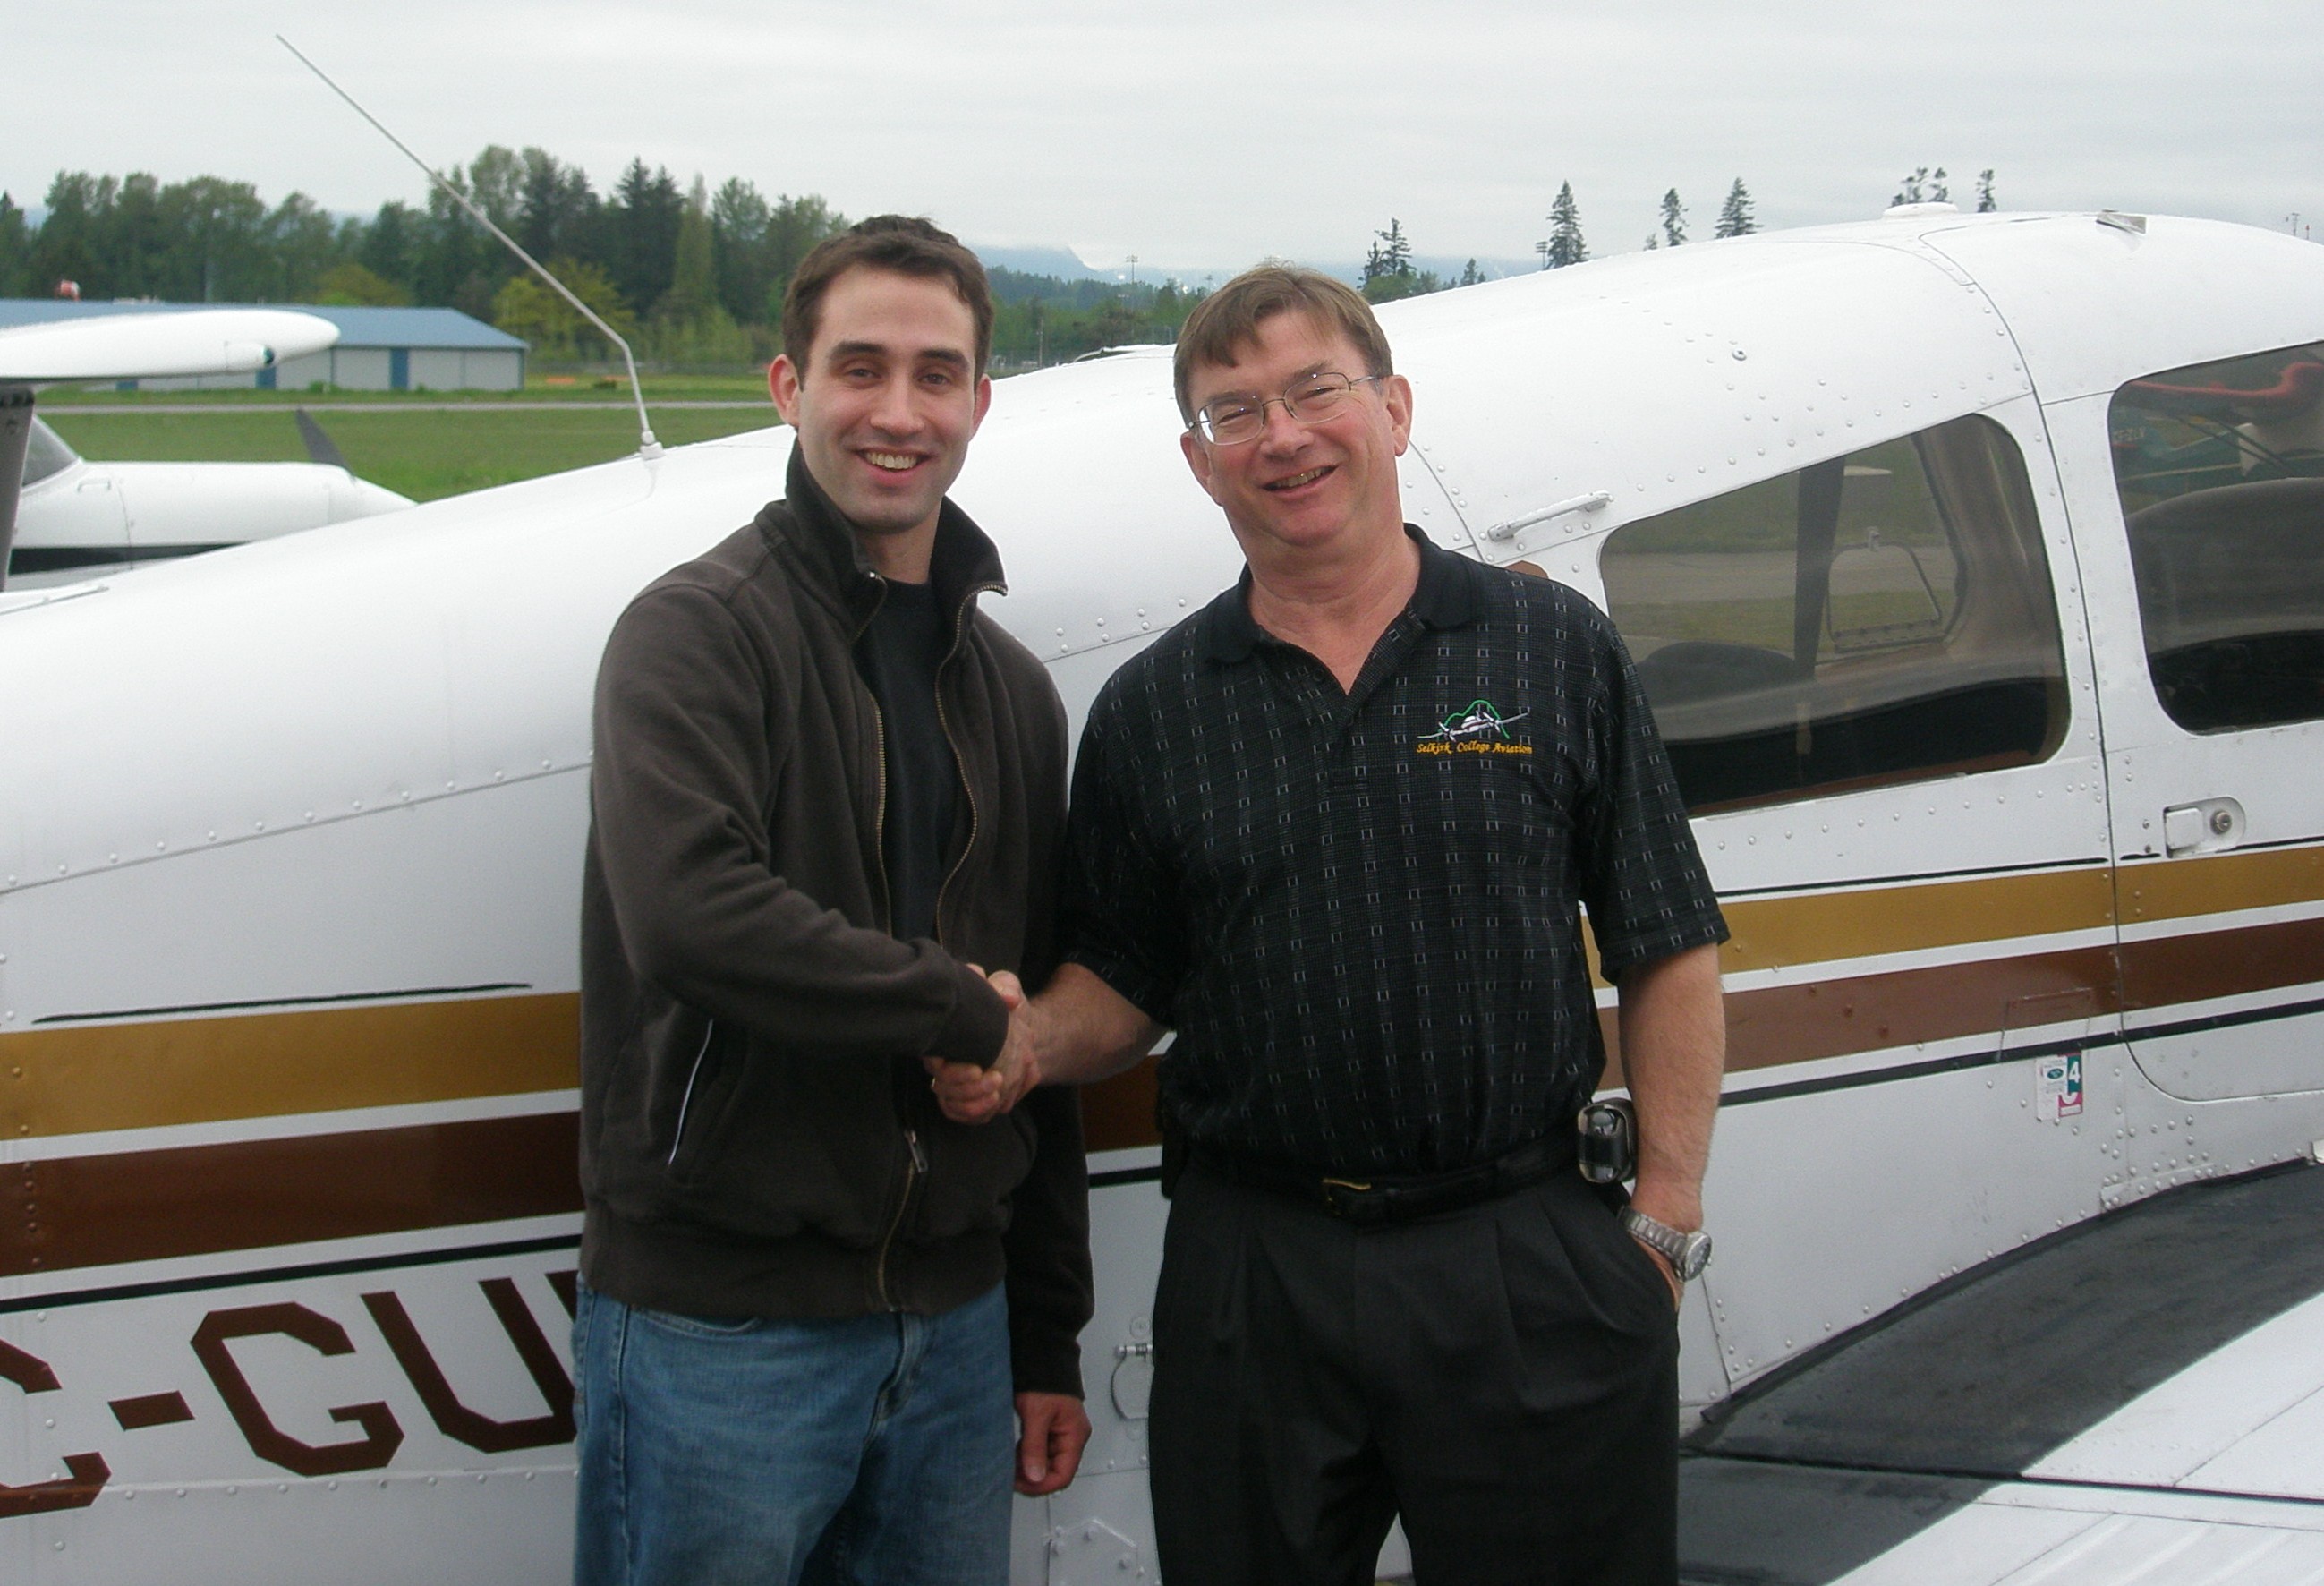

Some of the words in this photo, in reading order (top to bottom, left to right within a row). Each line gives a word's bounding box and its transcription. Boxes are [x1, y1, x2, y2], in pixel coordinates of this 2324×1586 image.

[1416, 741, 1453, 755] Selkirk
[1456, 739, 1490, 754] College
[1492, 741, 1533, 755] Aviation
[2068, 1061, 2081, 1084] 4
[0, 1269, 578, 1518] C-GU
